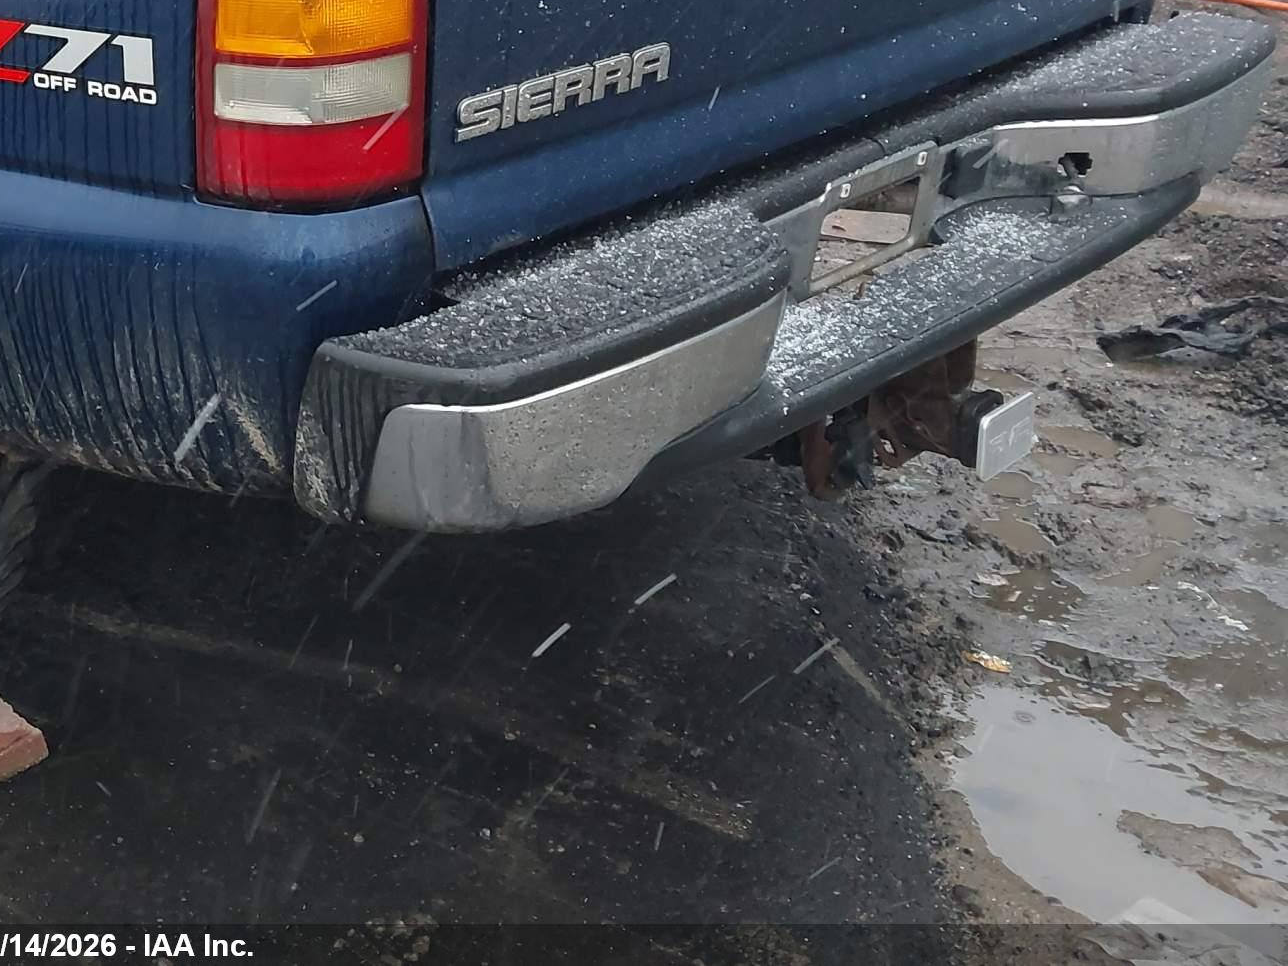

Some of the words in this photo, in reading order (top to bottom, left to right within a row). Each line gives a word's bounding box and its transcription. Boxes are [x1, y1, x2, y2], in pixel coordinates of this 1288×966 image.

[33, 73, 77, 92] OFF
[87, 81, 157, 105] ROAD
[454, 41, 671, 143] SIERRA
